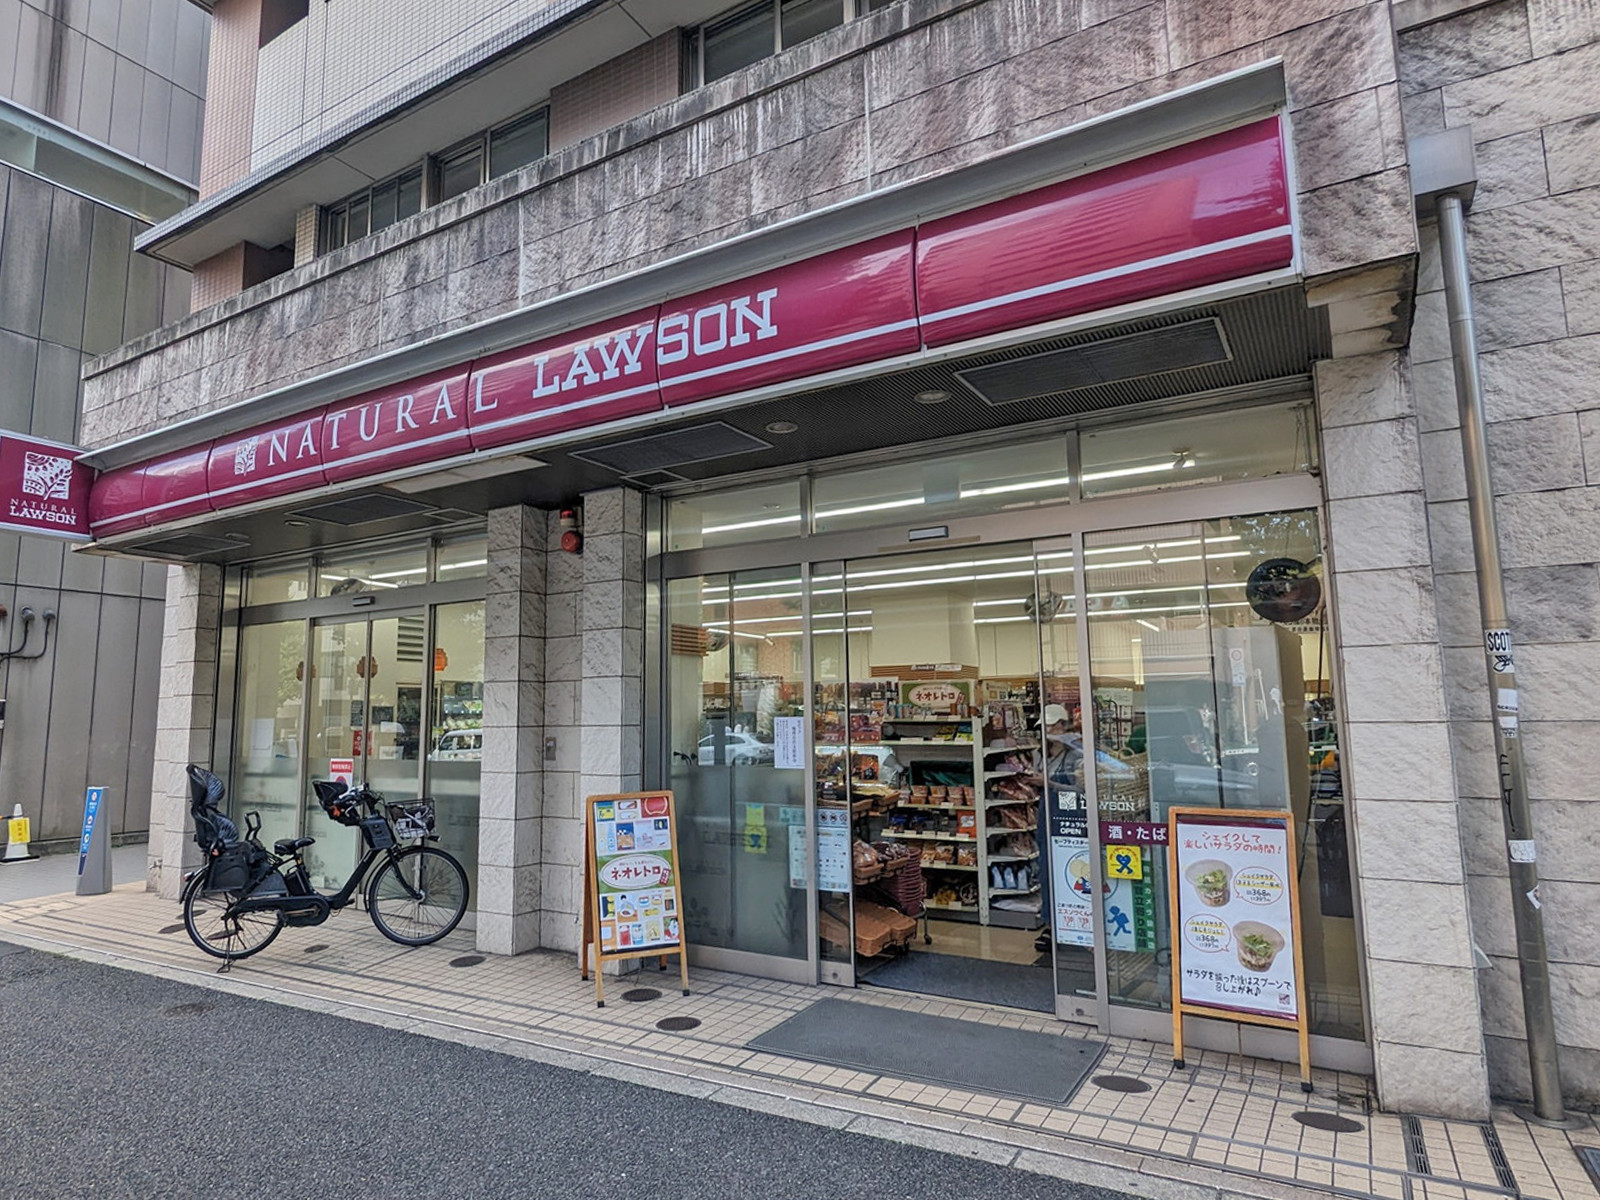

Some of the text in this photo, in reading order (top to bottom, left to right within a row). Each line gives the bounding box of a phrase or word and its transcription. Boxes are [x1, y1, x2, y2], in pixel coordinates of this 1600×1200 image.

[267, 287, 778, 467] NATURAL LAWSON
[10, 498, 76, 514] NATURAL
[10, 506, 76, 525] LAWSON
[916, 690, 956, 702] ネオレトロ
[1202, 832, 1261, 844] シェイクして
[611, 865, 661, 881] ネオレトロ
